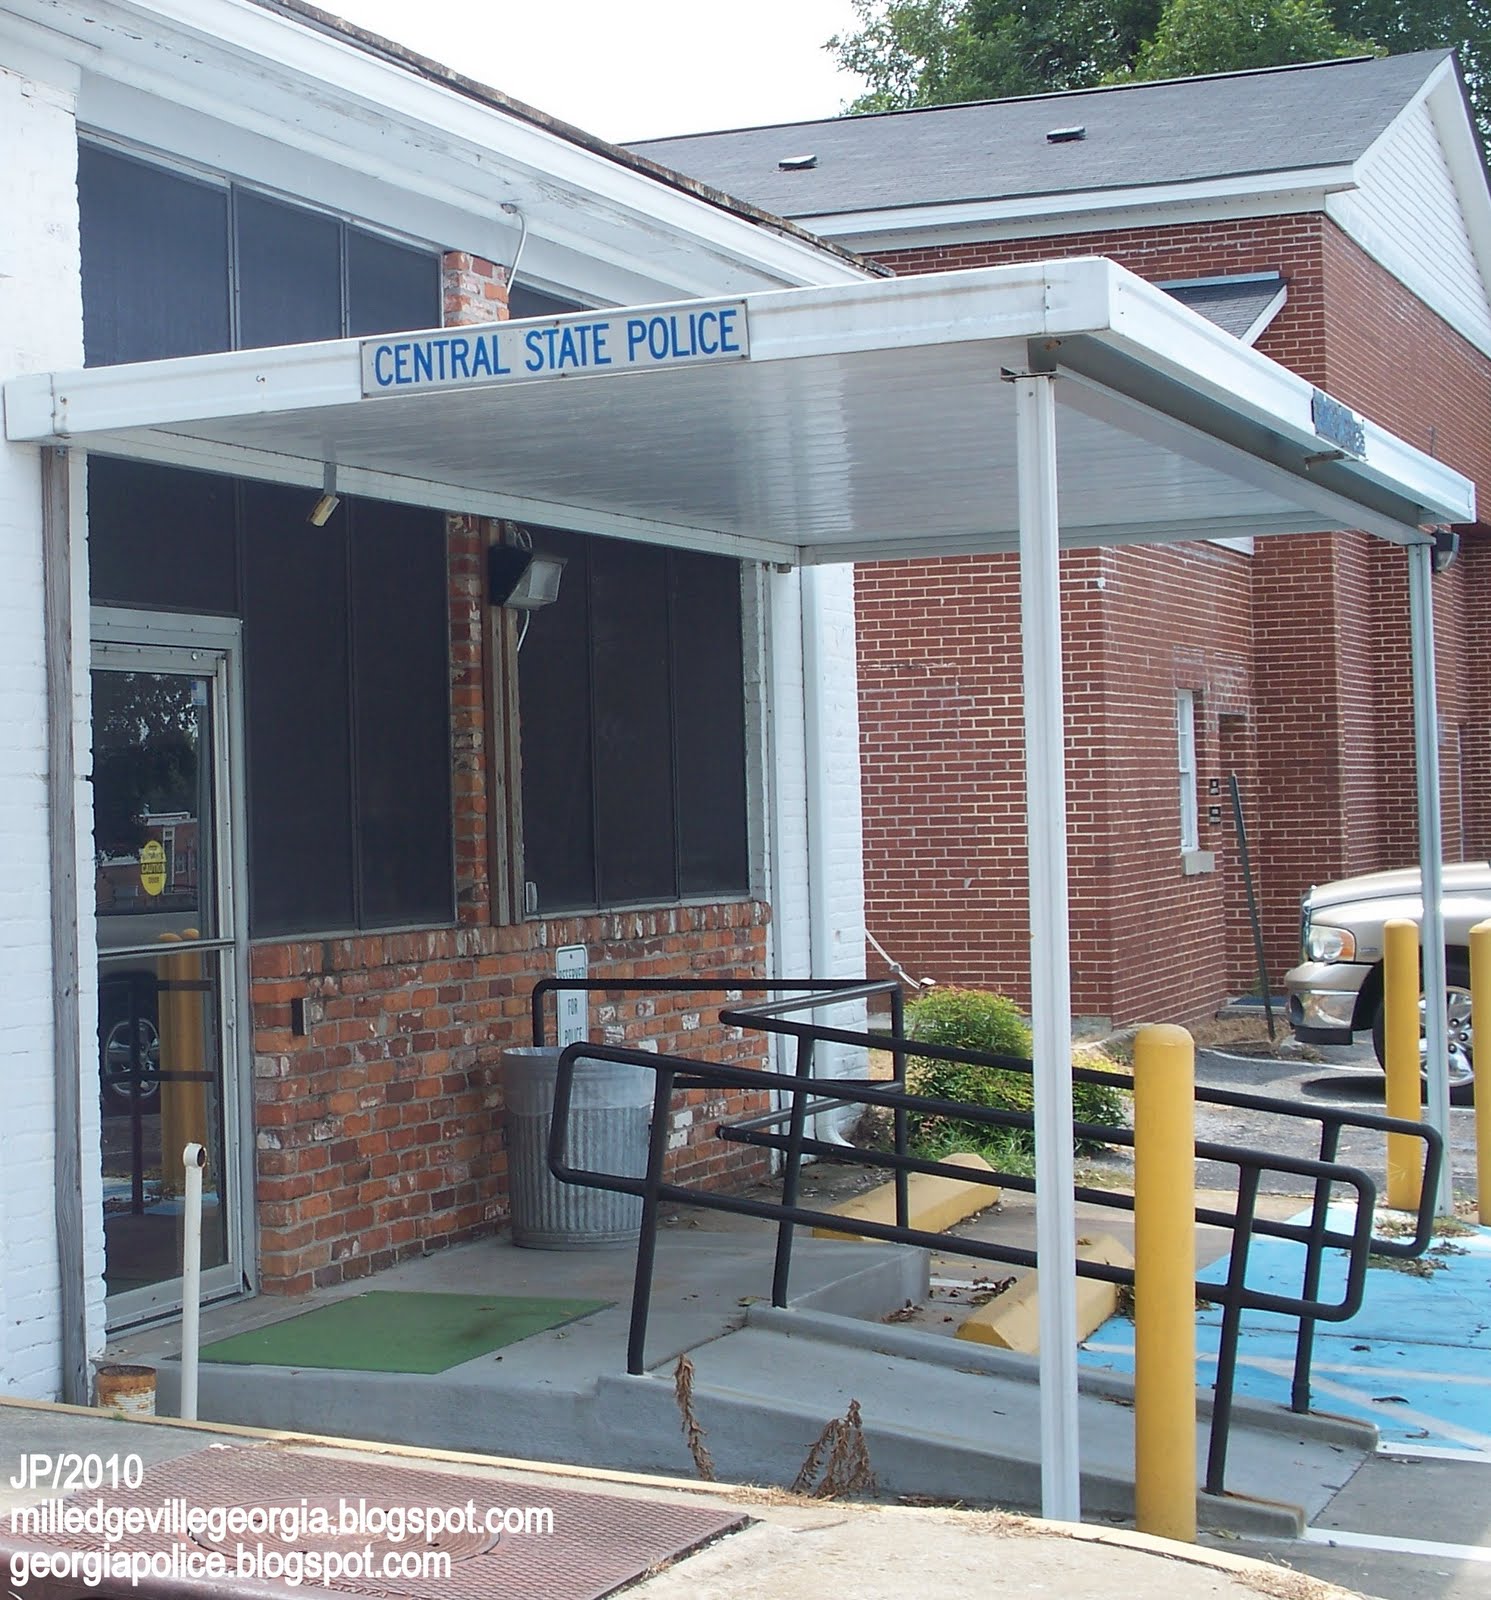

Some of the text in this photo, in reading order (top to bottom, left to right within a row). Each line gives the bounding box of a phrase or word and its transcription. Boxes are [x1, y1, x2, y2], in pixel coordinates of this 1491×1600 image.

[375, 308, 741, 386] CENTRAL STATE POLICE
[568, 998, 577, 1016] FOR
